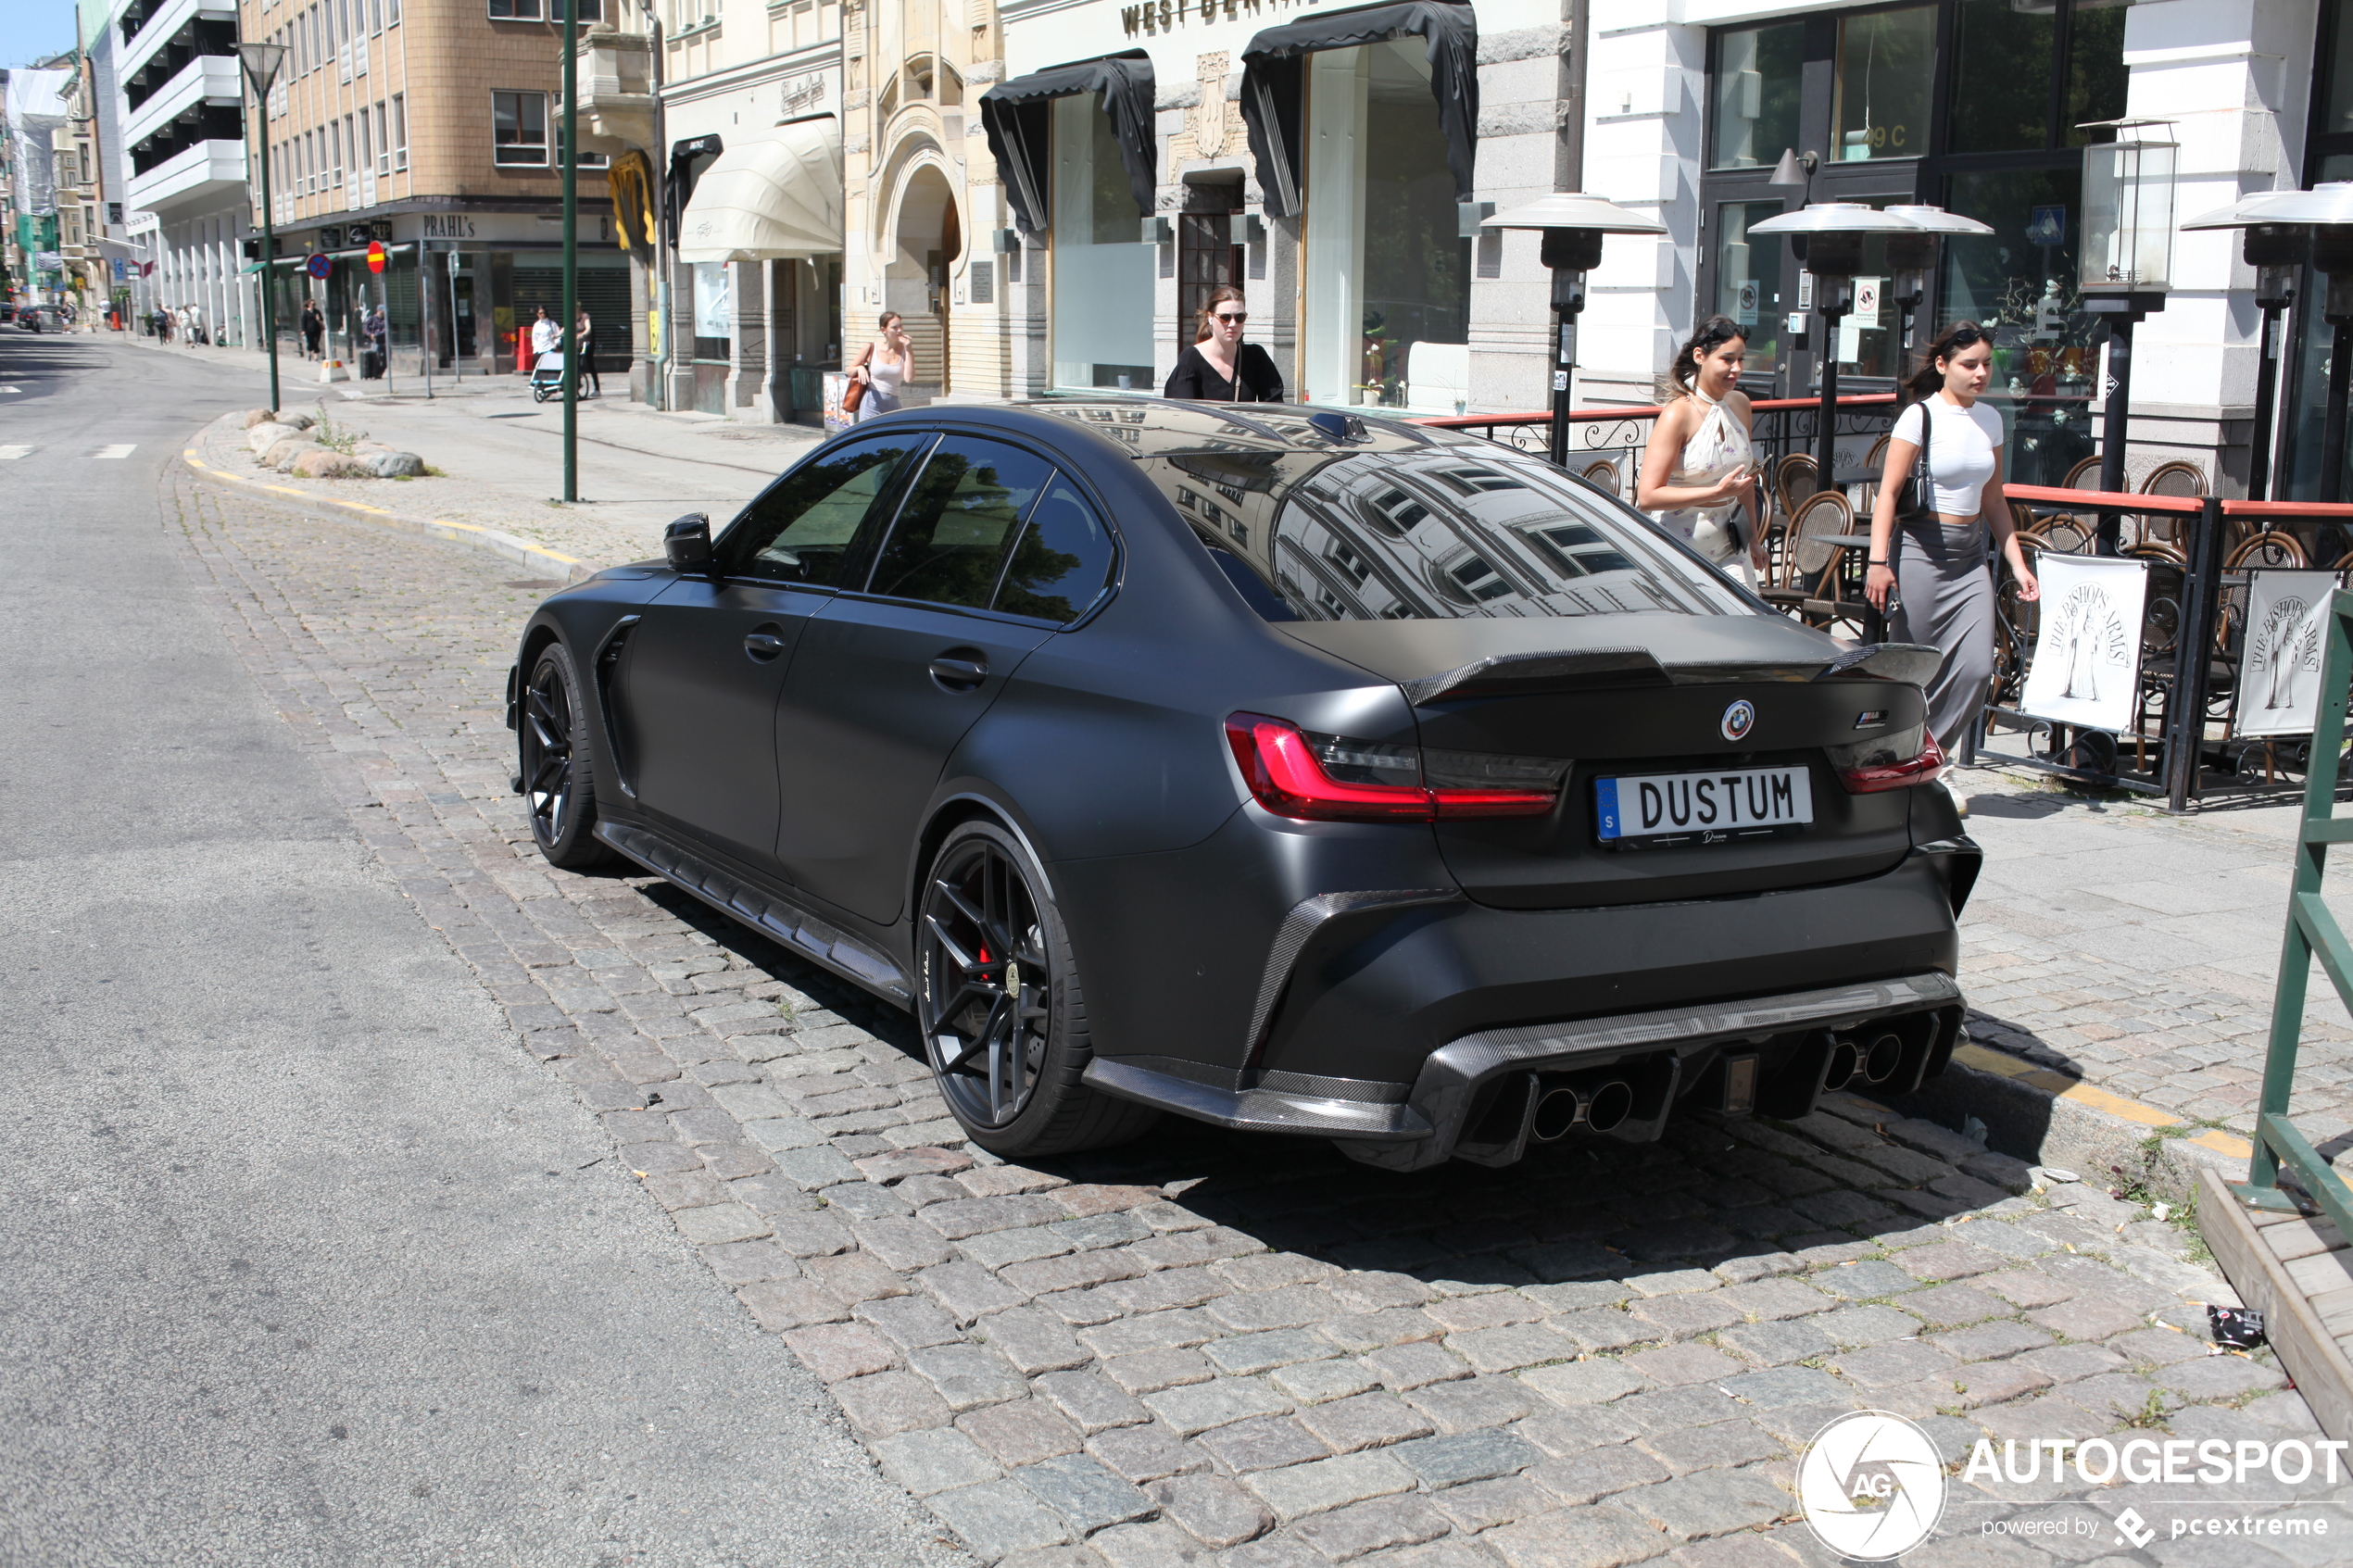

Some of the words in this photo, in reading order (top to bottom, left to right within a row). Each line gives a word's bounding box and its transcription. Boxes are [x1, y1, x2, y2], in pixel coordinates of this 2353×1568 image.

[1121, 0, 1186, 34] WEST
[1862, 126, 1886, 147] 49
[1891, 124, 1906, 146] C
[423, 215, 475, 238] PRAHL's
[2049, 616, 2068, 650] THE
[2062, 584, 2109, 619] BISHOPS
[2103, 610, 2126, 660] ARMS
[2252, 633, 2269, 668] THE
[2263, 598, 2308, 636] BISHOPS
[2301, 620, 2318, 666] ARMS
[1604, 815, 1614, 829] S
[1639, 773, 1794, 829] DUSTUM
